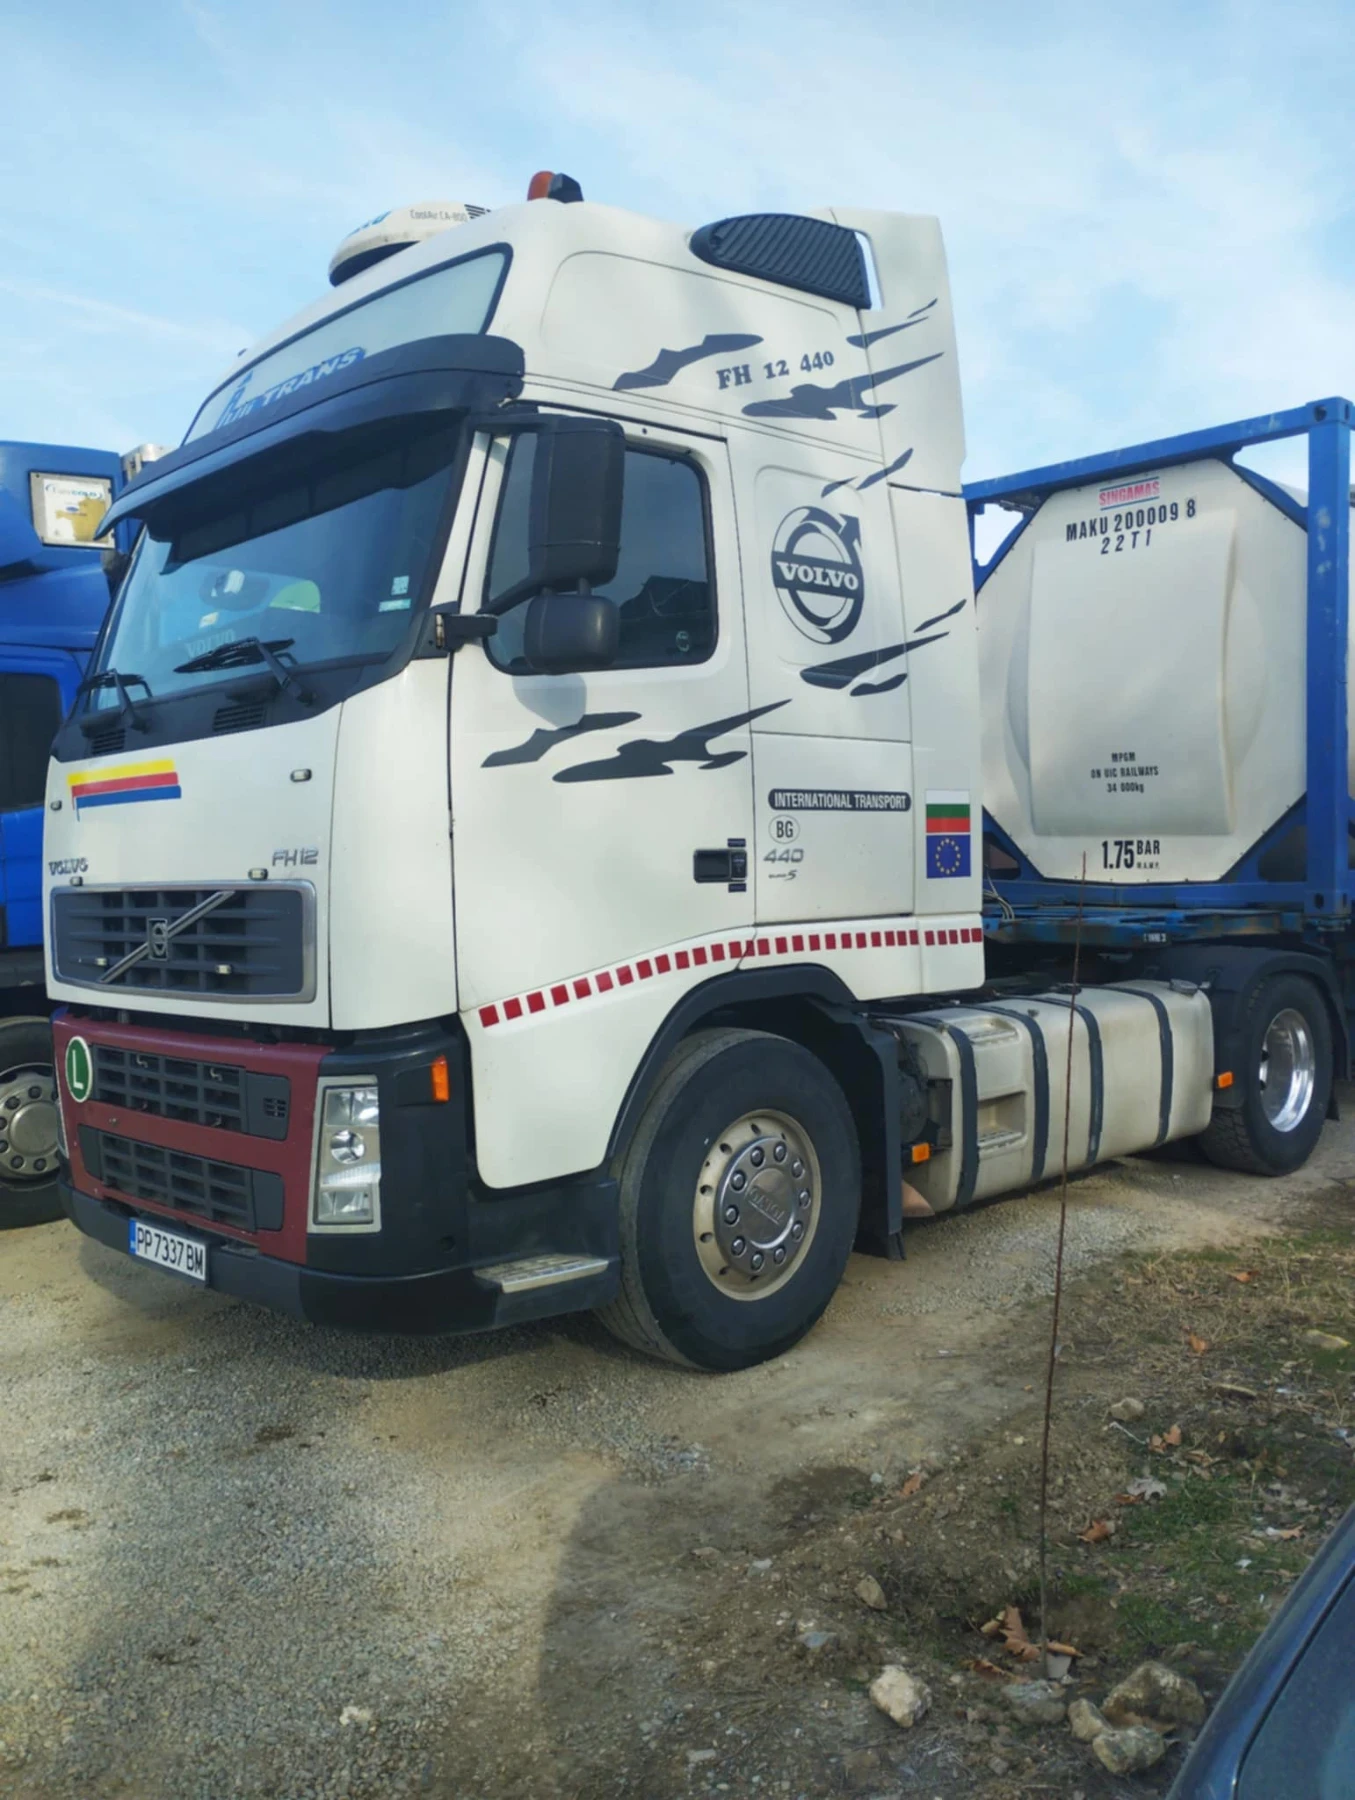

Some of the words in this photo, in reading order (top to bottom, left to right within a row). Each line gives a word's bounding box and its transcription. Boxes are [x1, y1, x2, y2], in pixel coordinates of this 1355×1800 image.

[260, 348, 363, 407] TRANS
[716, 363, 752, 390] FH
[763, 359, 790, 379] 12
[800, 350, 835, 373] 440
[1098, 480, 1161, 507] SINGAMAS
[1066, 516, 1109, 542] MAKU
[776, 560, 859, 591] VOLVO
[1090, 768, 1102, 780] ON
[1120, 765, 1160, 778] RAILWAYS
[774, 791, 853, 809] INTERNATIONAL
[853, 793, 907, 810] TRANSPORT
[1107, 782, 1118, 794] 34
[776, 820, 794, 839] BG
[48, 856, 89, 876] VOLVO
[763, 848, 804, 863] 440
[1101, 840, 1135, 870] 1.75
[1136, 839, 1161, 855] BAR
[72, 1049, 84, 1090] L
